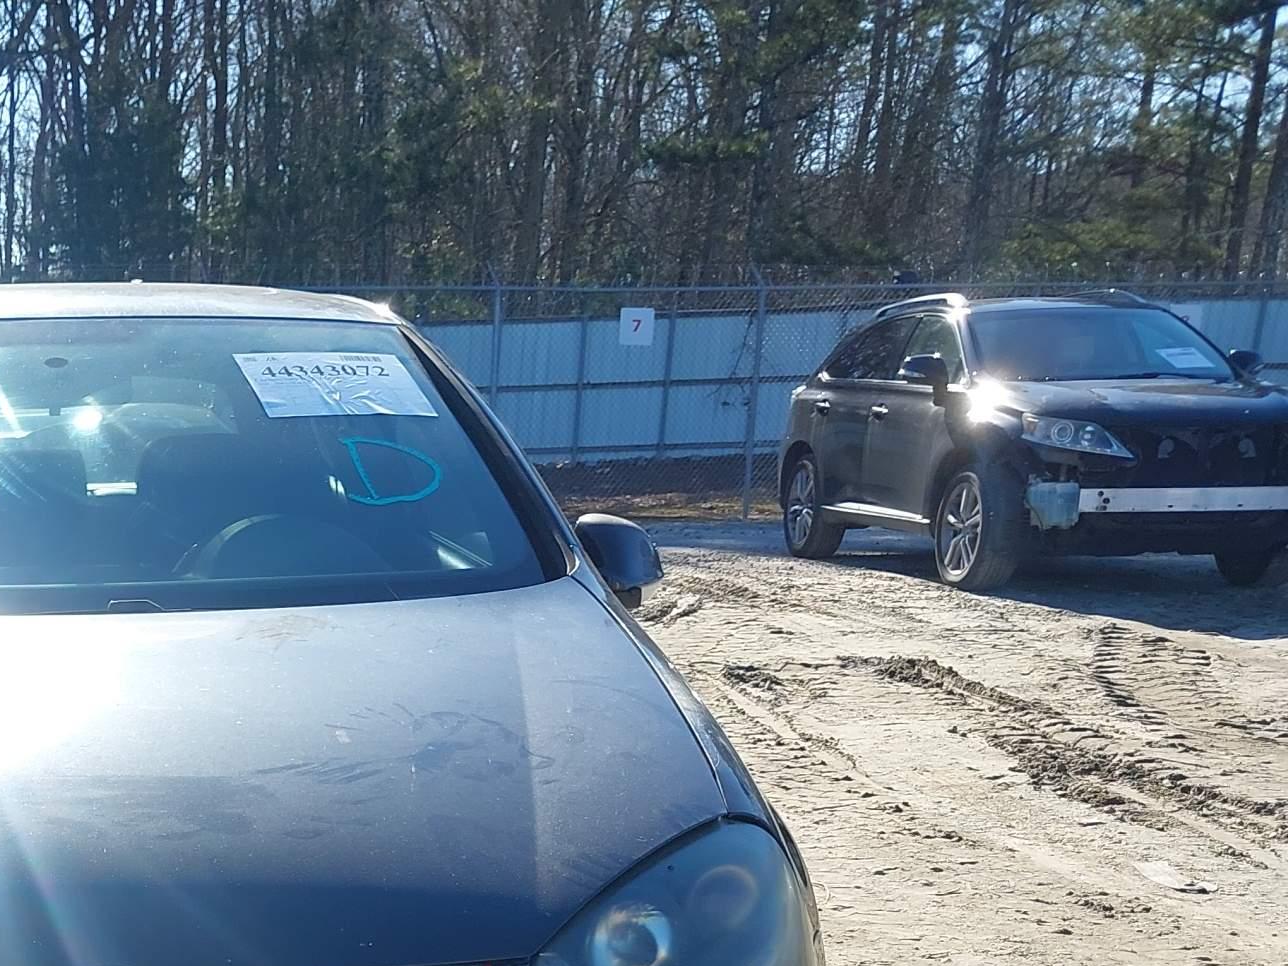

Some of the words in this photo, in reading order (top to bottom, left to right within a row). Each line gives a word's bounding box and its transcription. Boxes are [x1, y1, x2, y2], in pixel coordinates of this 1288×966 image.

[632, 319, 642, 332] 7
[261, 364, 390, 378] 44343072
[339, 437, 441, 505] D
